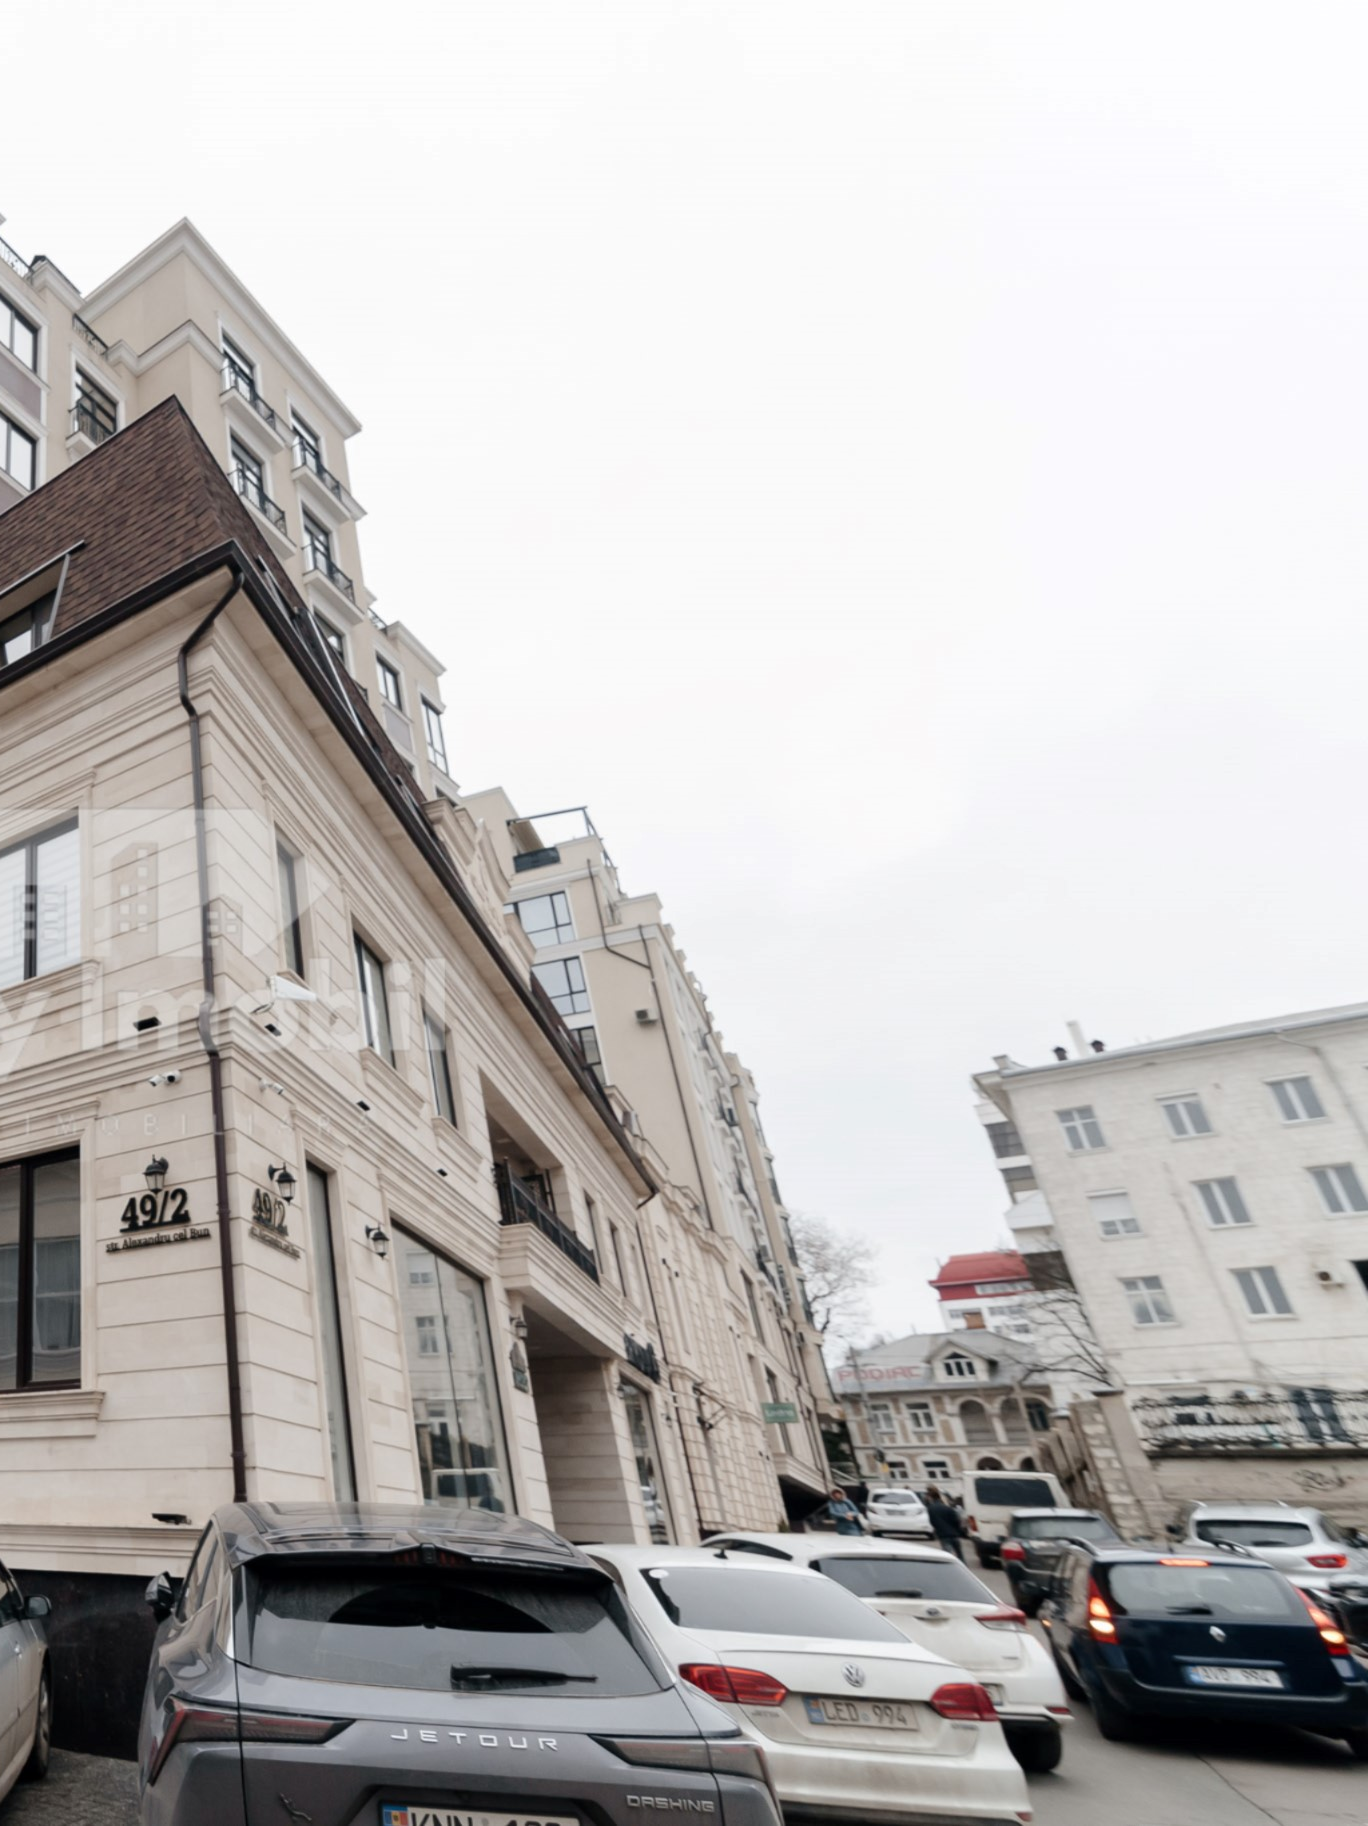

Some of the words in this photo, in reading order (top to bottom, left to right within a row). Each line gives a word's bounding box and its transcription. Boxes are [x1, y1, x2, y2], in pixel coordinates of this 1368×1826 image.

[120, 1188, 190, 1231] 49/2
[252, 1188, 289, 1236] 49/2
[122, 1233, 171, 1250] Alexandru
[173, 1229, 187, 1242] cel
[190, 1228, 211, 1239] Bun
[822, 1700, 860, 1722] LED
[872, 1704, 908, 1726] 994
[391, 1729, 558, 1751] JETOUR
[626, 1795, 715, 1813] DASHING
